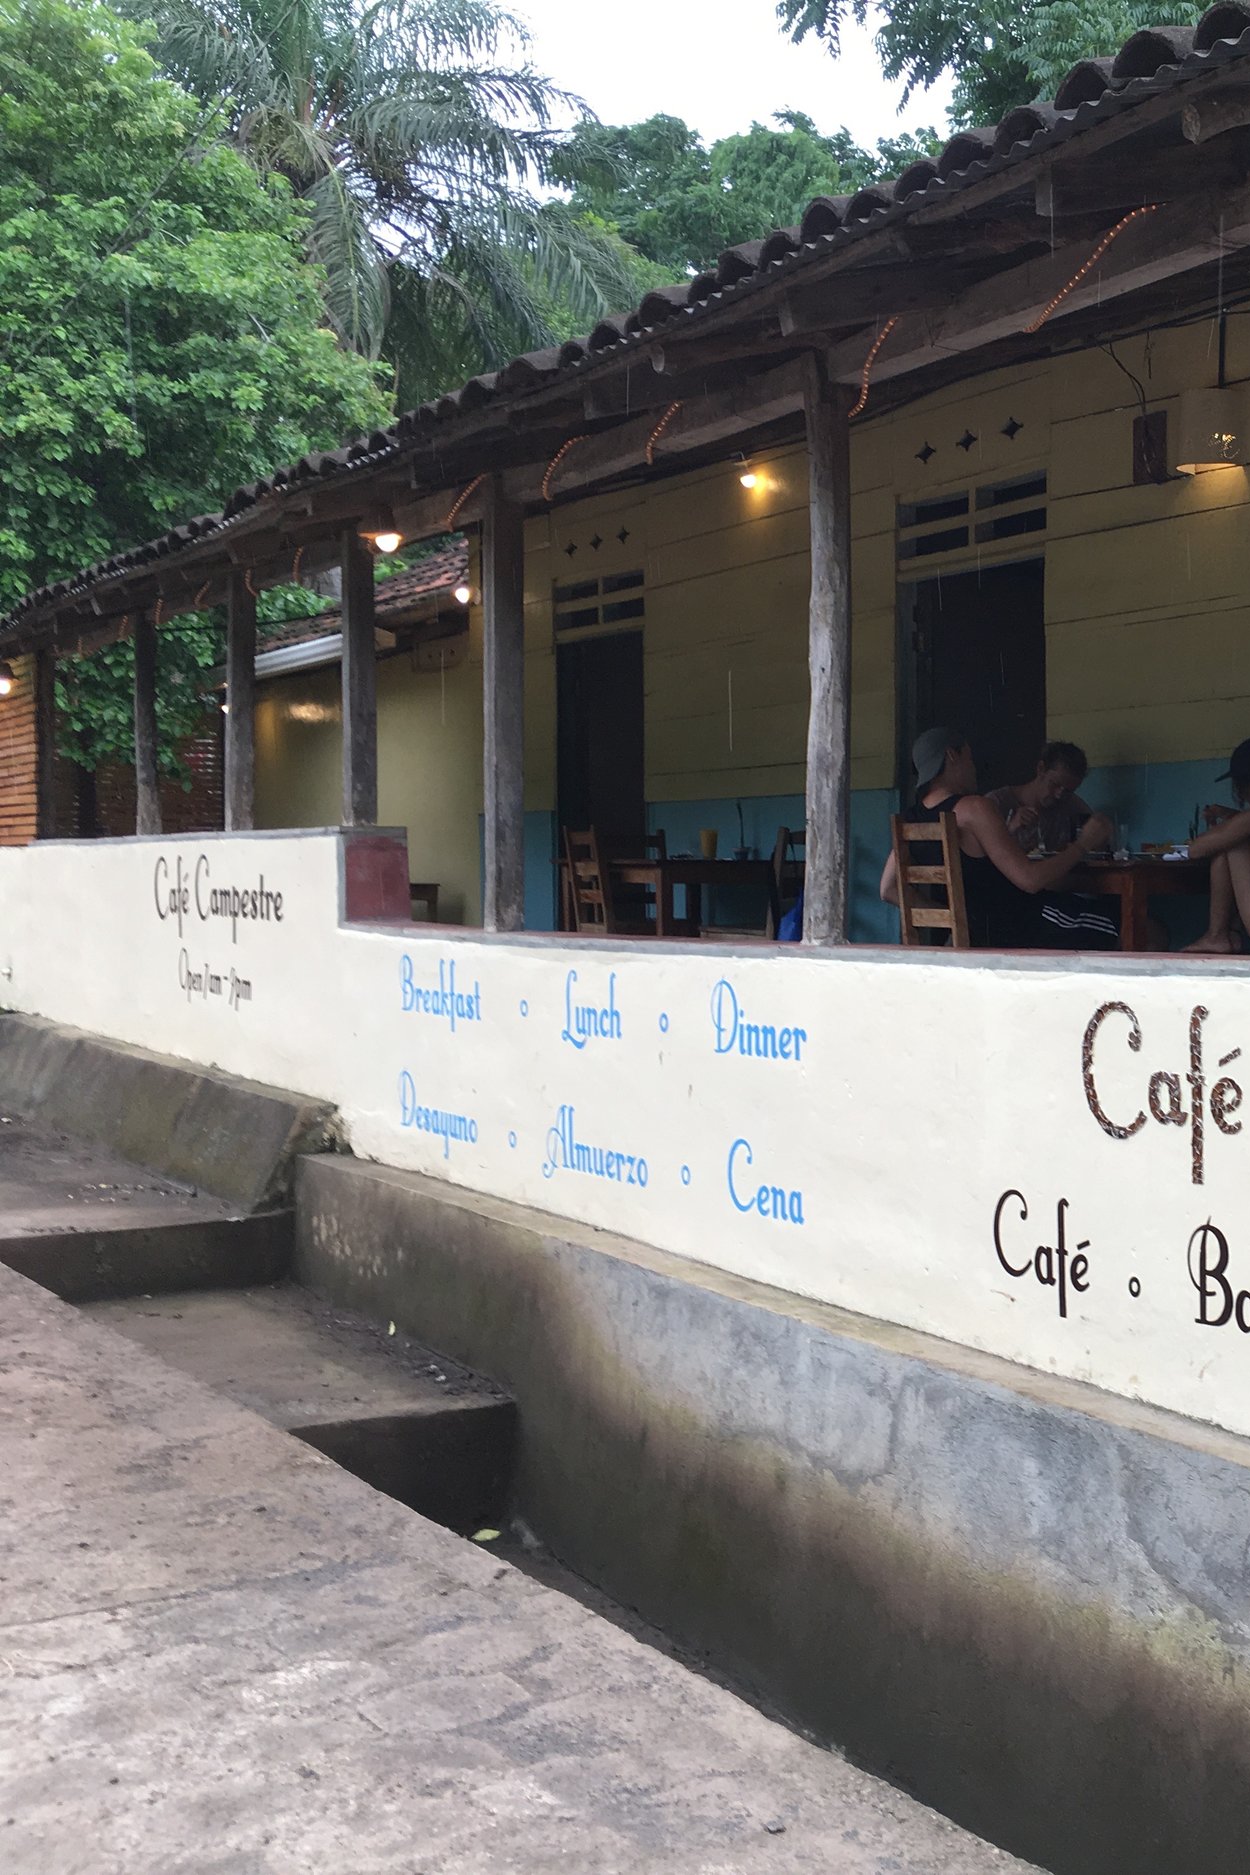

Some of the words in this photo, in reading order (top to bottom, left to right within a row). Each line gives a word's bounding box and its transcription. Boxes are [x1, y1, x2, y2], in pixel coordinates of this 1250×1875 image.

[154, 856, 189, 938] Café
[195, 854, 283, 944] Campestre
[178, 947, 202, 1003] Open
[400, 954, 481, 1032] Breakfast
[562, 970, 622, 1049] Lunch
[711, 979, 807, 1061] Dinner
[398, 1071, 477, 1159] Desayuno
[543, 1105, 648, 1187] Almuerzo
[728, 1139, 804, 1225] Cena
[1082, 1001, 1243, 1185] Café
[993, 1189, 1091, 1320] Café
